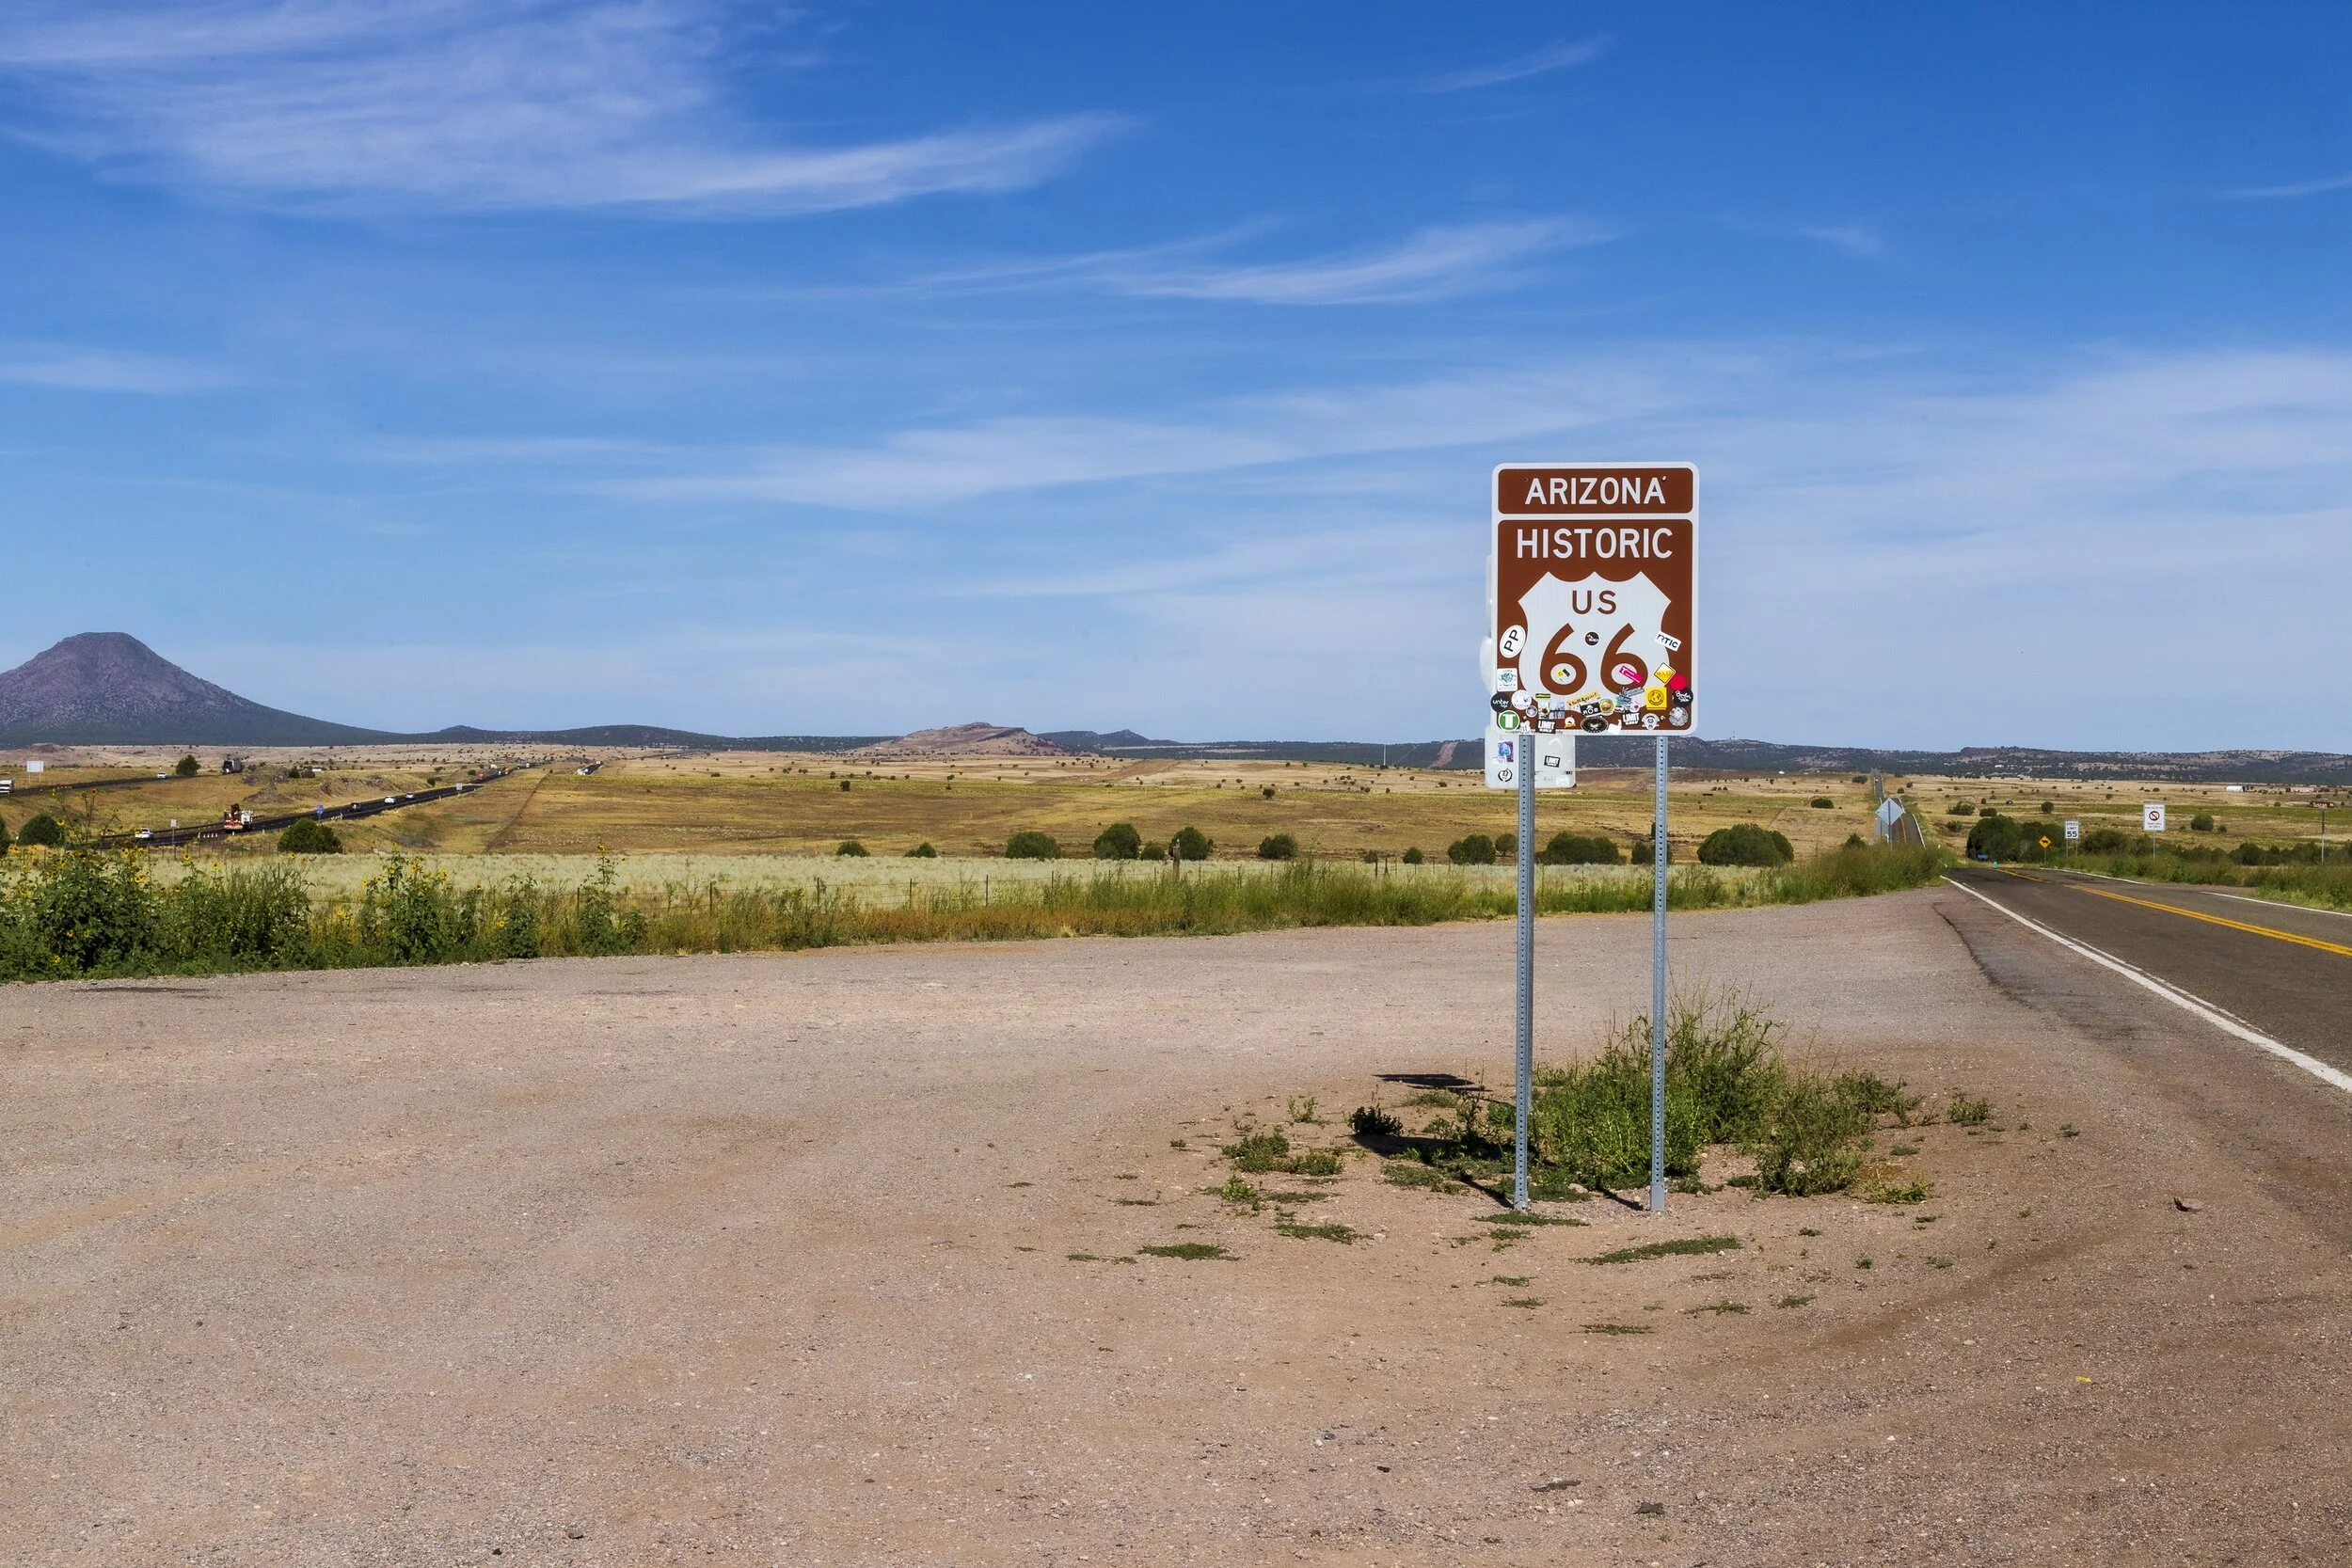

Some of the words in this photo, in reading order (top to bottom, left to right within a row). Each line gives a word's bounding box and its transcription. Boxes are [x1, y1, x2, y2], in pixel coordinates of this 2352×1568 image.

[1524, 477, 1666, 505] ARIZONA
[1517, 528, 1673, 559] HISTORIC
[1572, 590, 1616, 614] US
[1540, 623, 1648, 695] 66
